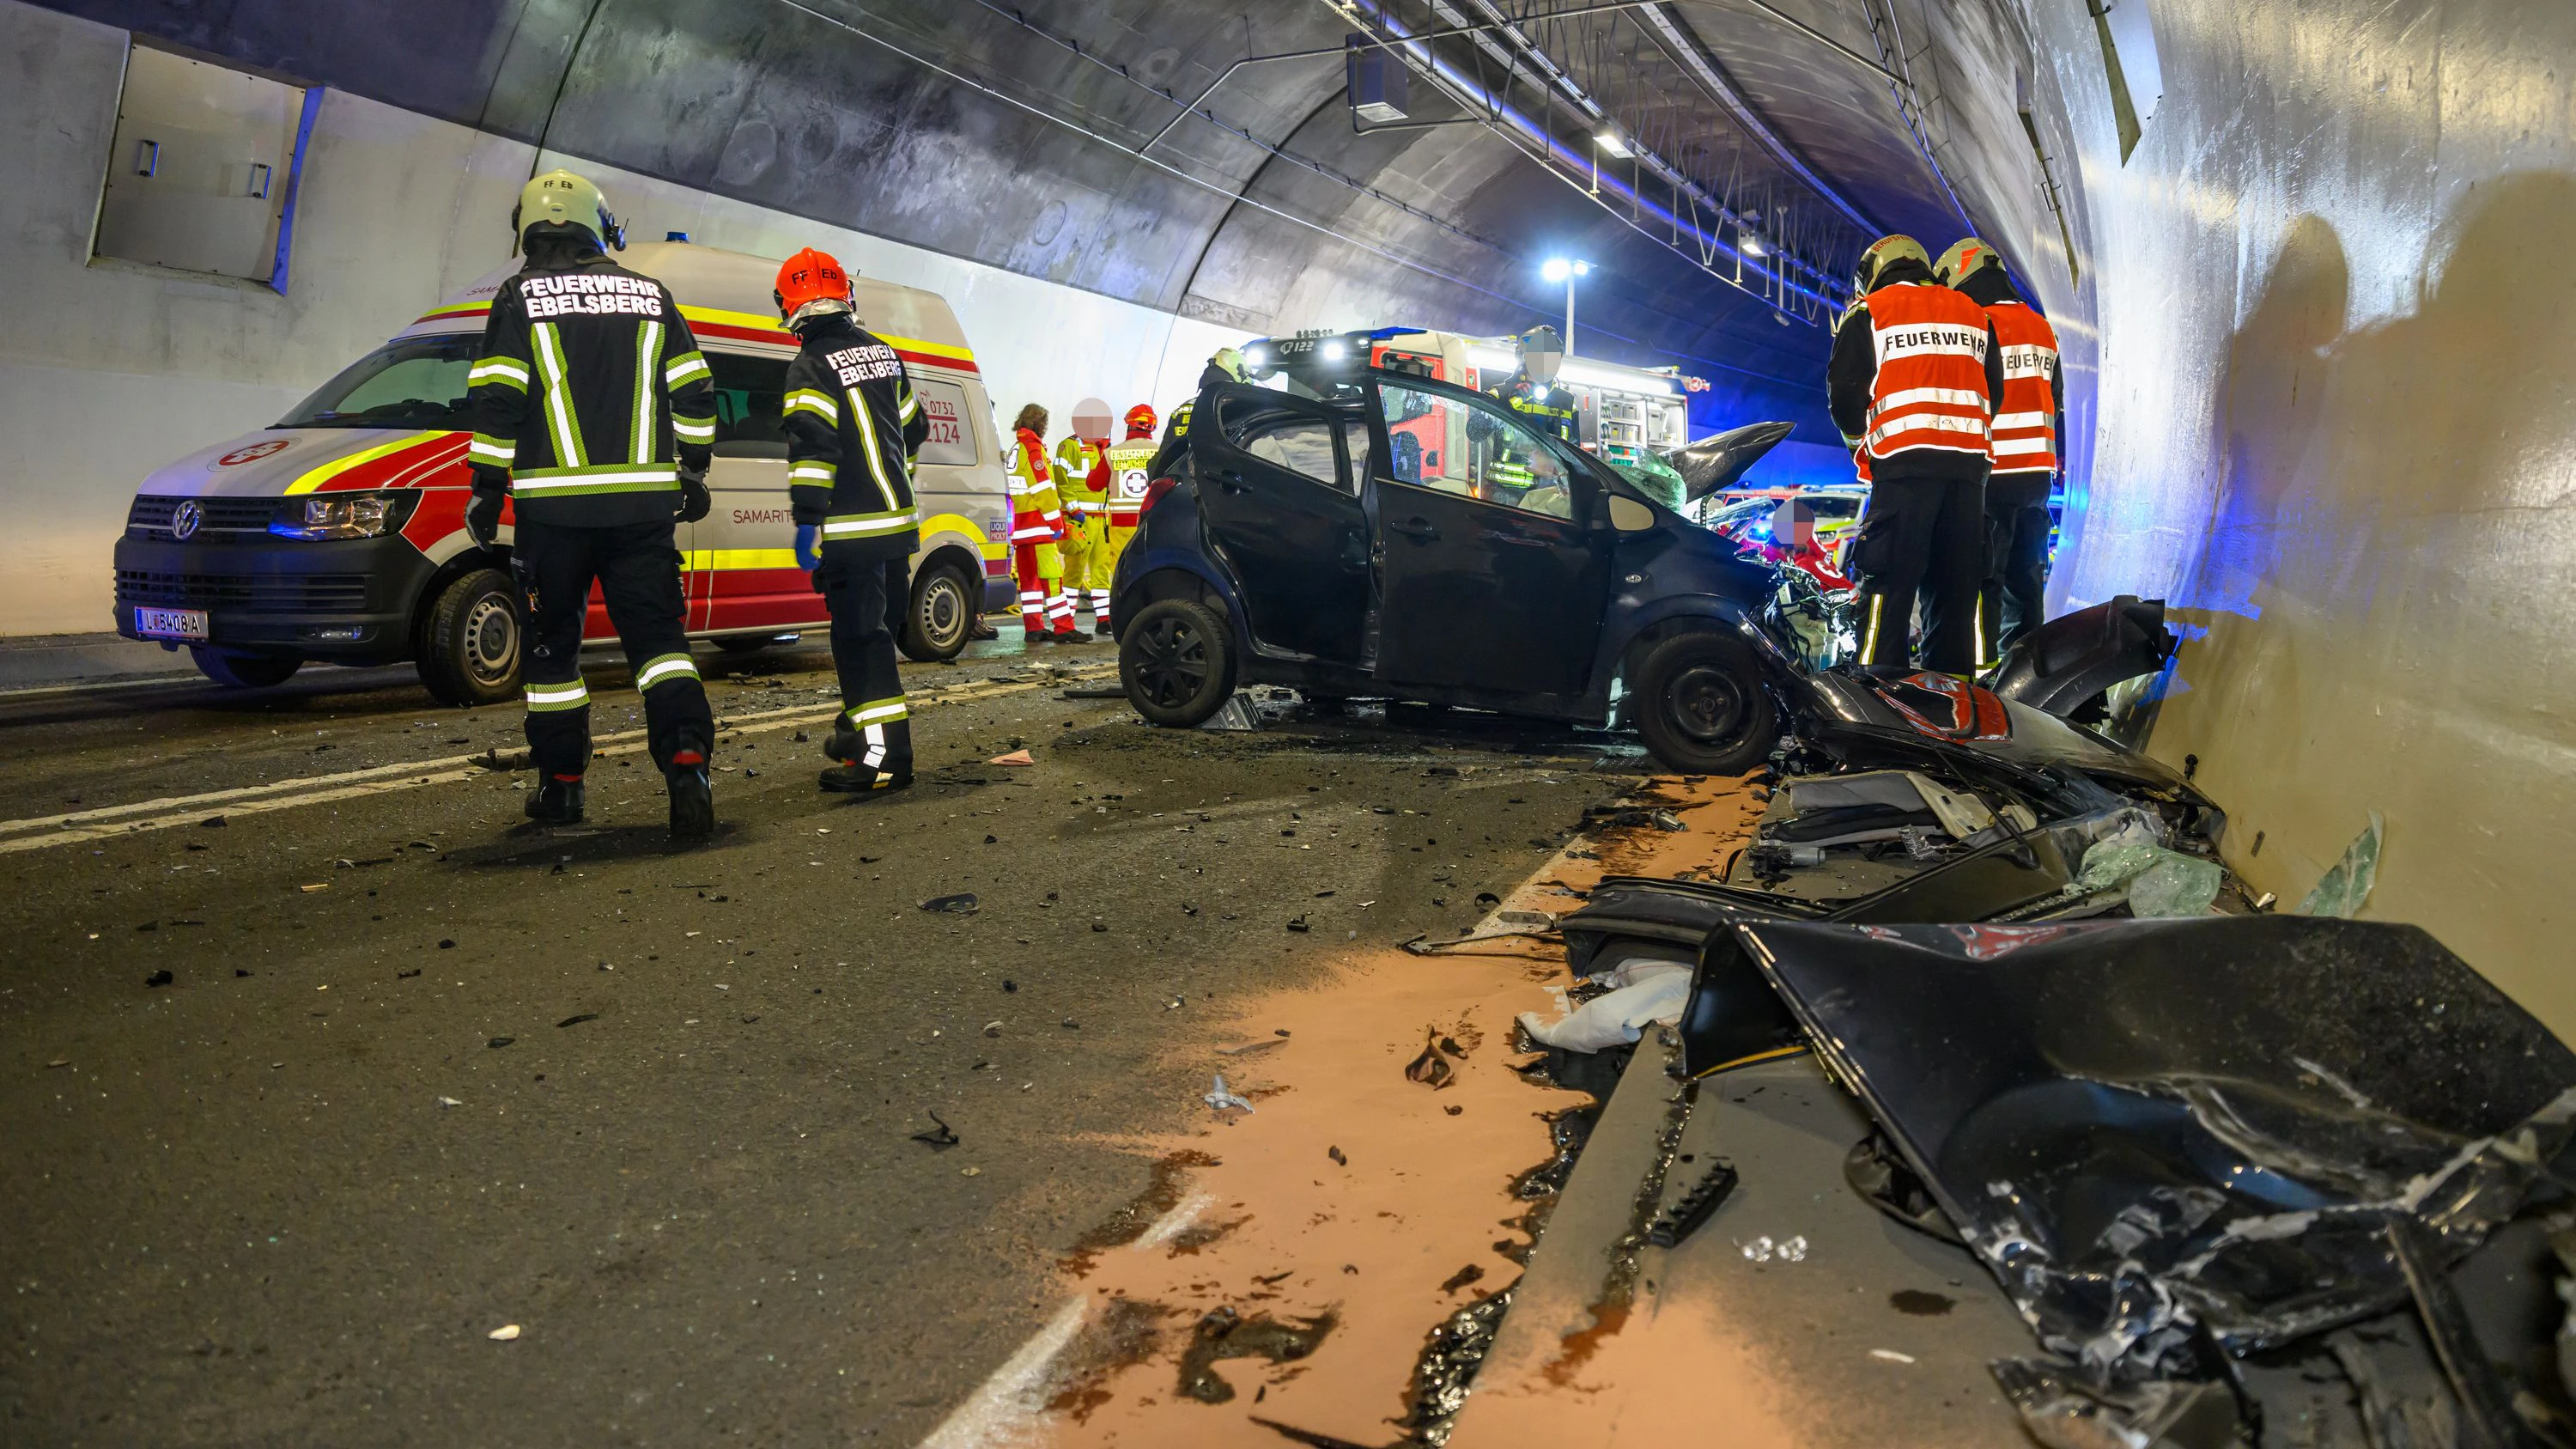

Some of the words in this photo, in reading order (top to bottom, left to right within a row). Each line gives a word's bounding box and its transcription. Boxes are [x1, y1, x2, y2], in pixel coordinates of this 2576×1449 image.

[561, 180, 573, 189] Eb
[792, 270, 808, 284] FF
[821, 268, 837, 280] Eb
[519, 275, 662, 299] FEUERWEHR
[526, 294, 662, 319] EBELSBERG
[1294, 341, 1314, 352] 122
[1885, 332, 1985, 355] FEUERWEHR
[838, 361, 902, 387] EBELSBERG
[930, 400, 955, 415] 0732
[927, 423, 960, 444] 124
[733, 509, 792, 523] SAMARIT
[990, 532, 1006, 540] MOLY
